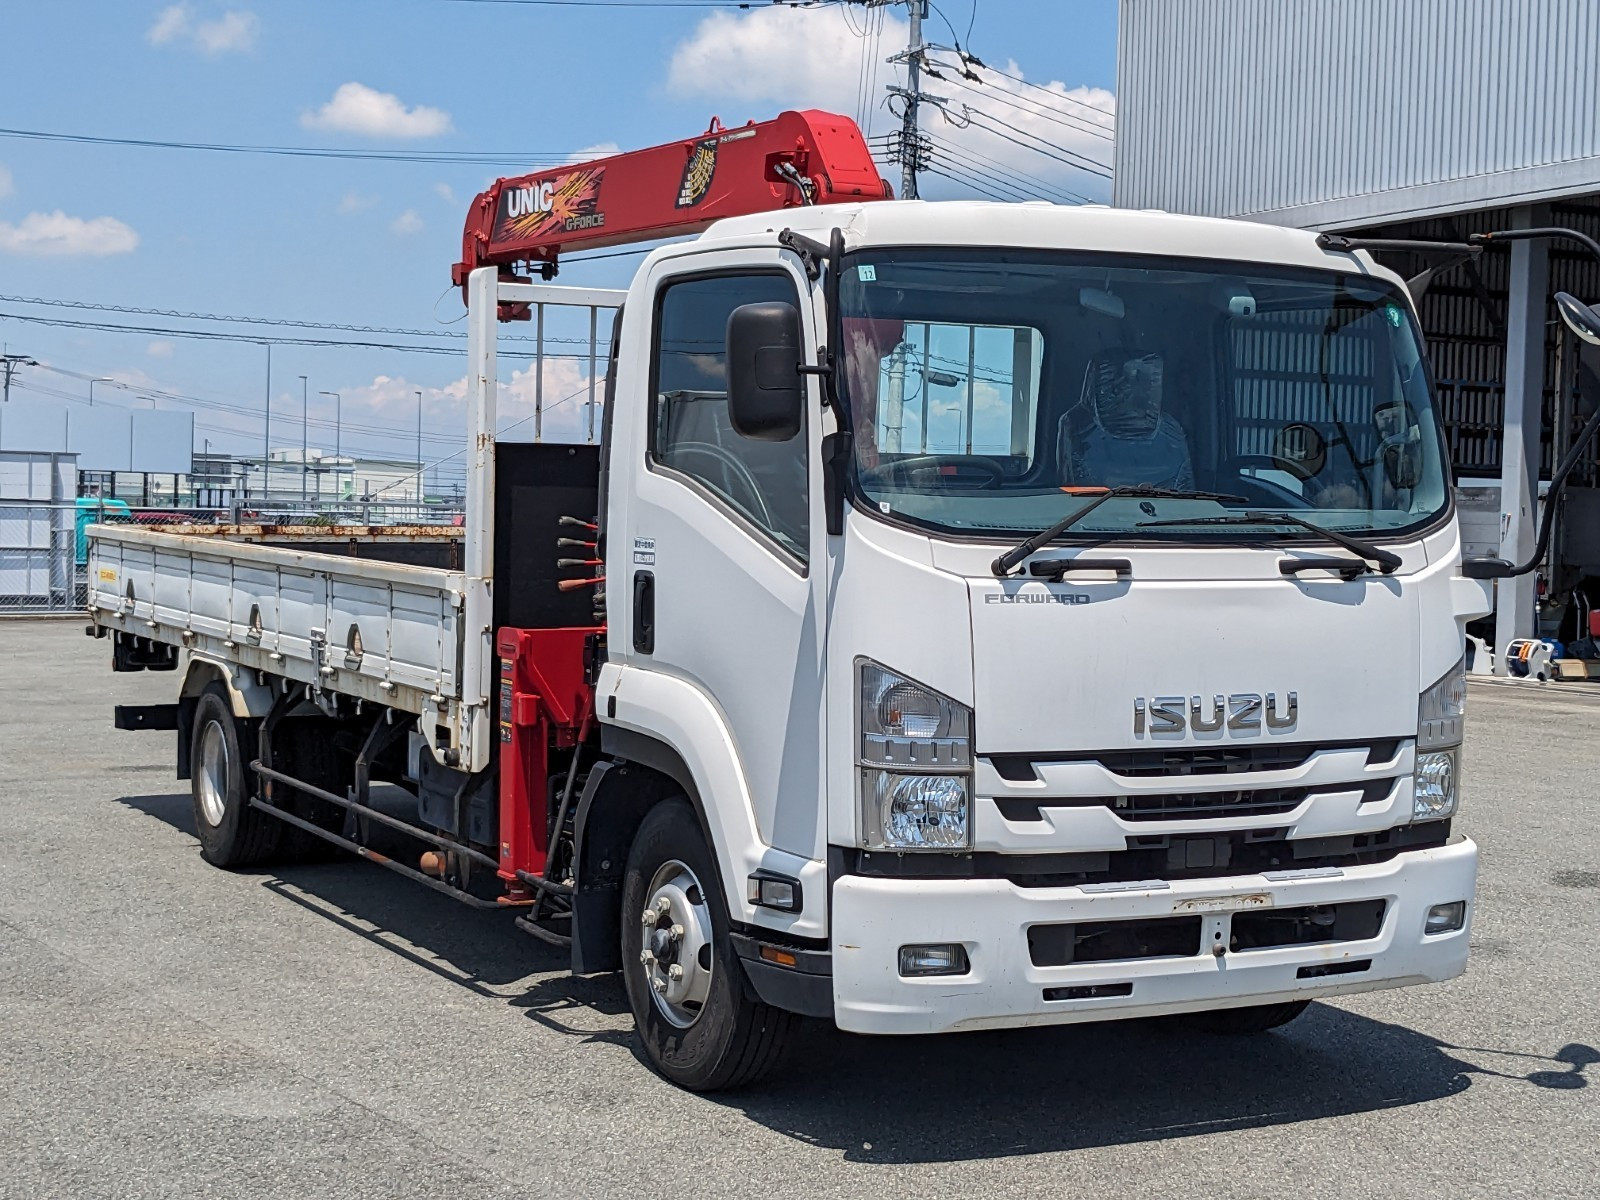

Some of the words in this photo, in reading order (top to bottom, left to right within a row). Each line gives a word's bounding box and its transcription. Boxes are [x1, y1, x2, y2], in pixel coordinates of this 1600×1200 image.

[508, 182, 553, 218] UNIC
[985, 594, 1090, 605] FORWARD
[1134, 692, 1297, 735] ISUZU
